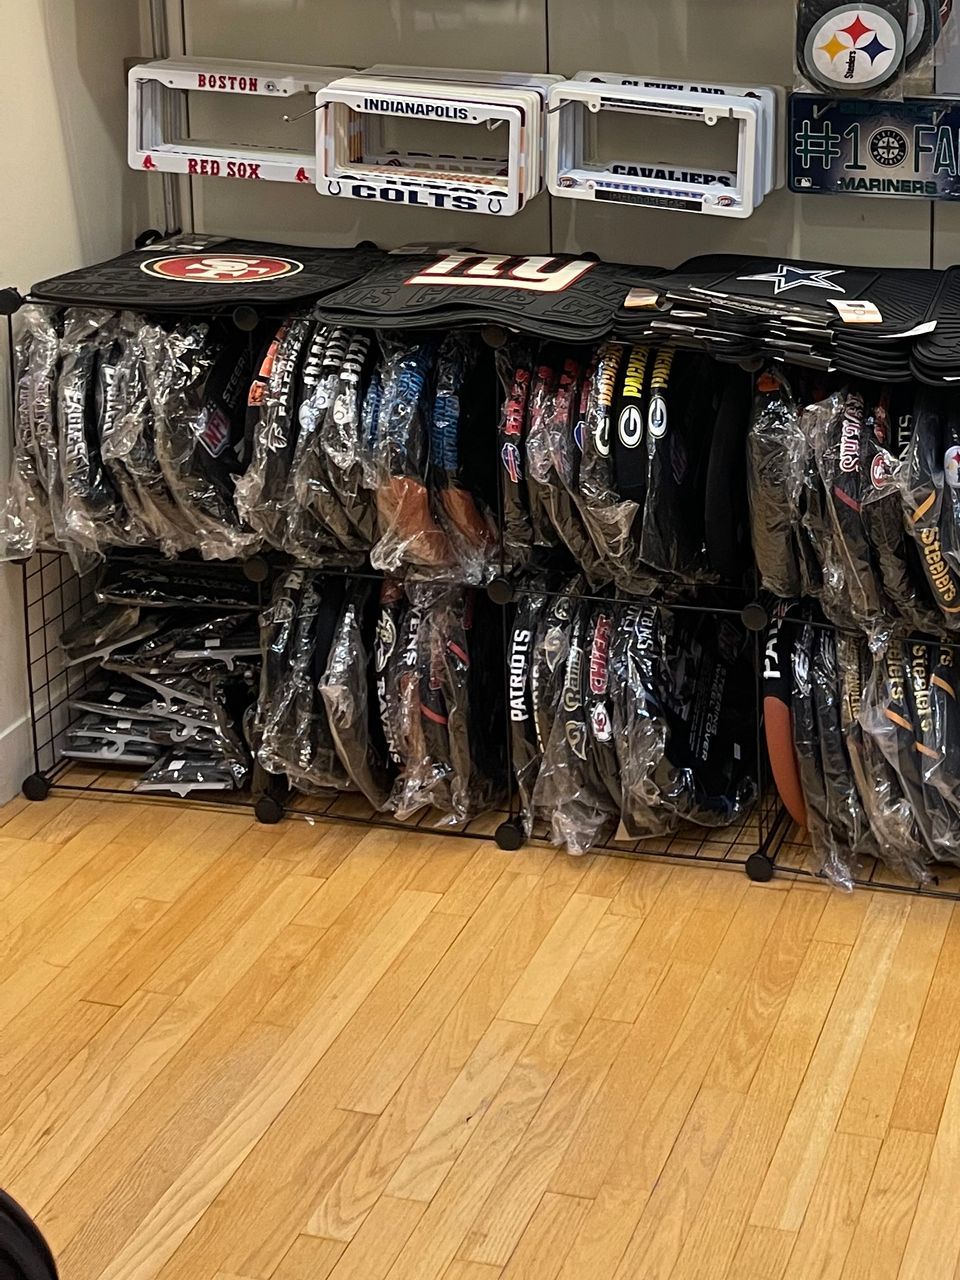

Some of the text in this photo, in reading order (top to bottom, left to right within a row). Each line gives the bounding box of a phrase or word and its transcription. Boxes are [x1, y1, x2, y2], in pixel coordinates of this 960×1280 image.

[198, 73, 258, 92] BOSTON
[844, 50, 857, 79] Steelers
[364, 97, 469, 120] INDIANAPOLIS
[187, 158, 261, 180] RED SOX
[795, 120, 867, 171] #1
[351, 184, 478, 211] COLTS
[839, 177, 938, 194] MARINERS
[278, 340, 301, 416] FALCONS
[64, 388, 87, 459] EAGLES
[920, 527, 956, 600] Steelers
[510, 628, 531, 722] PATRIOTS
[563, 646, 584, 712] Rams
[589, 613, 613, 695] CHIEFS
[911, 645, 933, 732] Steelers
[376, 676, 402, 764] RAVENS
[701, 713, 714, 762] COVER
